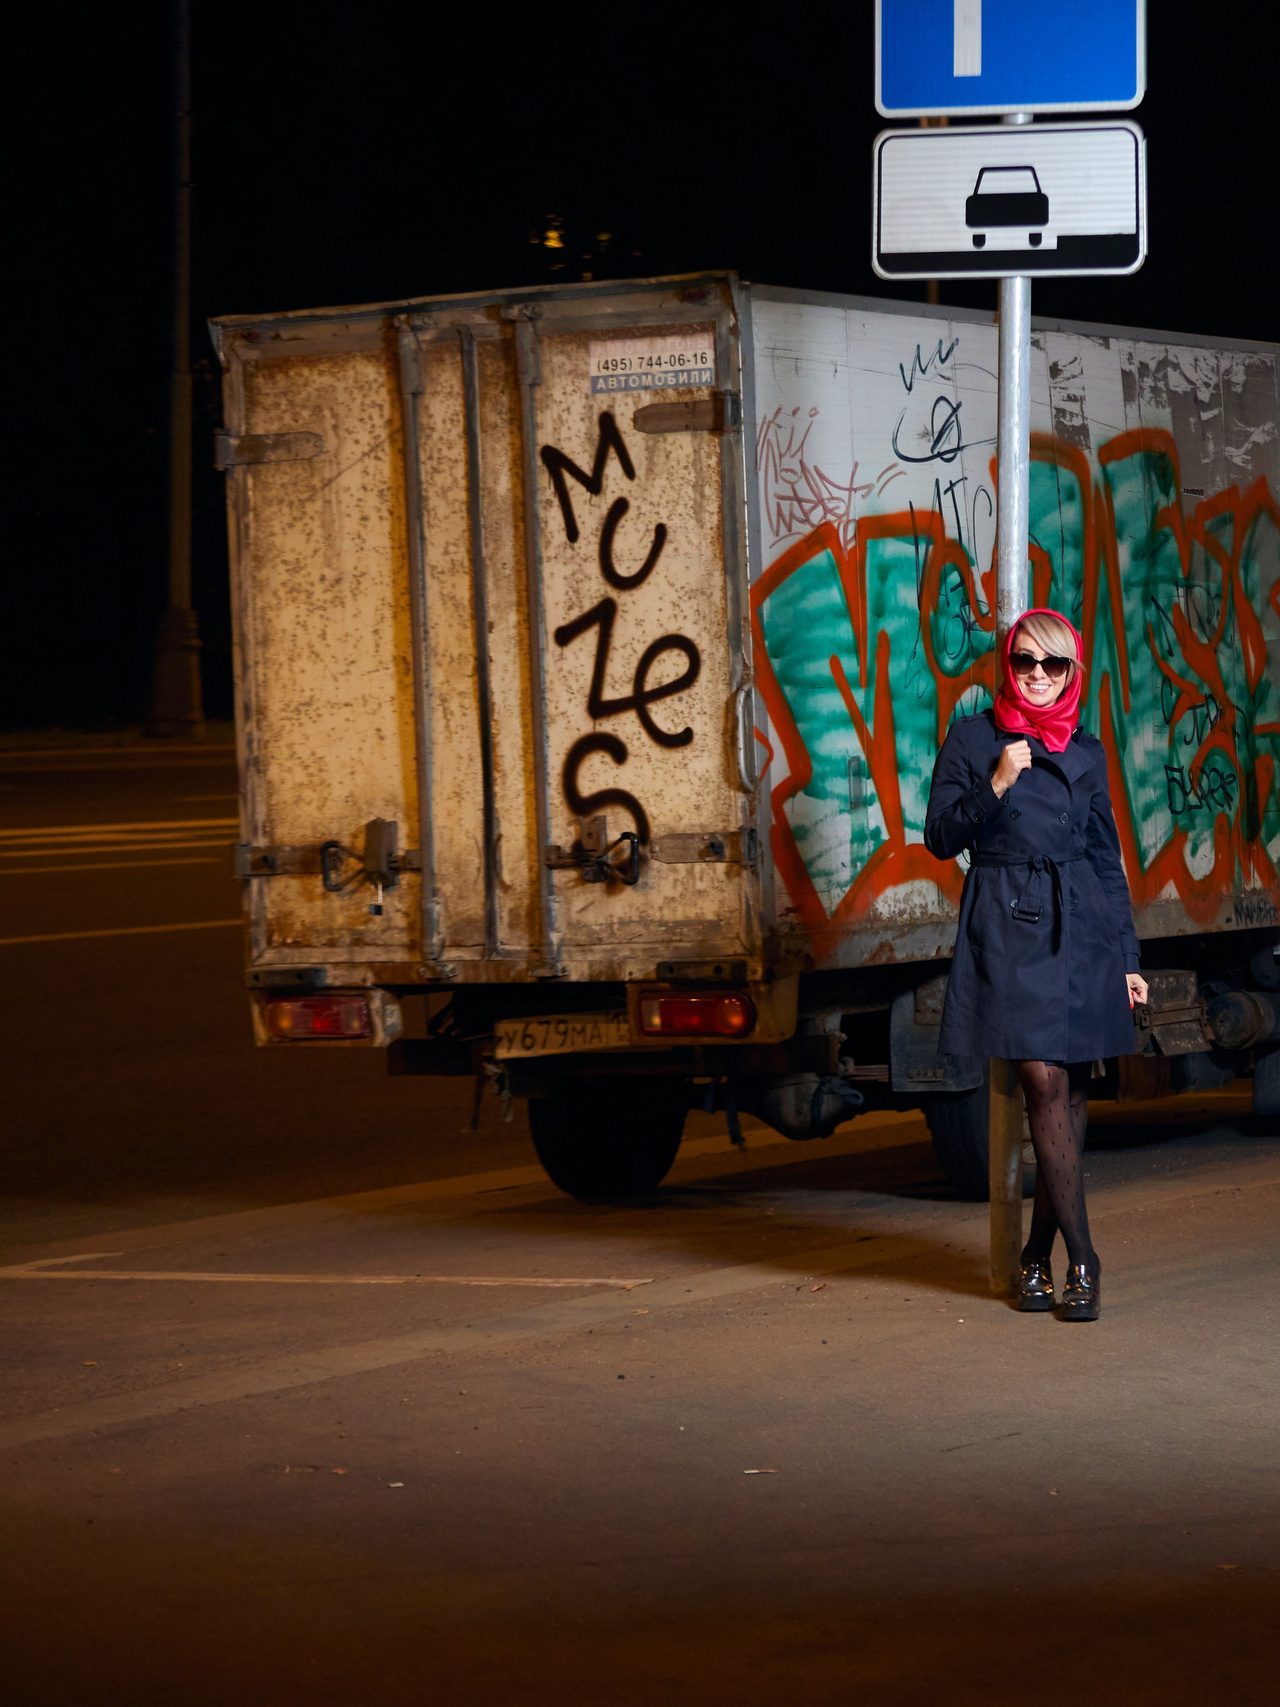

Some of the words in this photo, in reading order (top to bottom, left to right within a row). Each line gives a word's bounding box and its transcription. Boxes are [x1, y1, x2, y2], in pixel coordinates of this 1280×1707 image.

[597, 358, 633, 373] (495)
[638, 352, 708, 369] 744-06-16
[596, 369, 711, 390] АВТОМОБИЛИ
